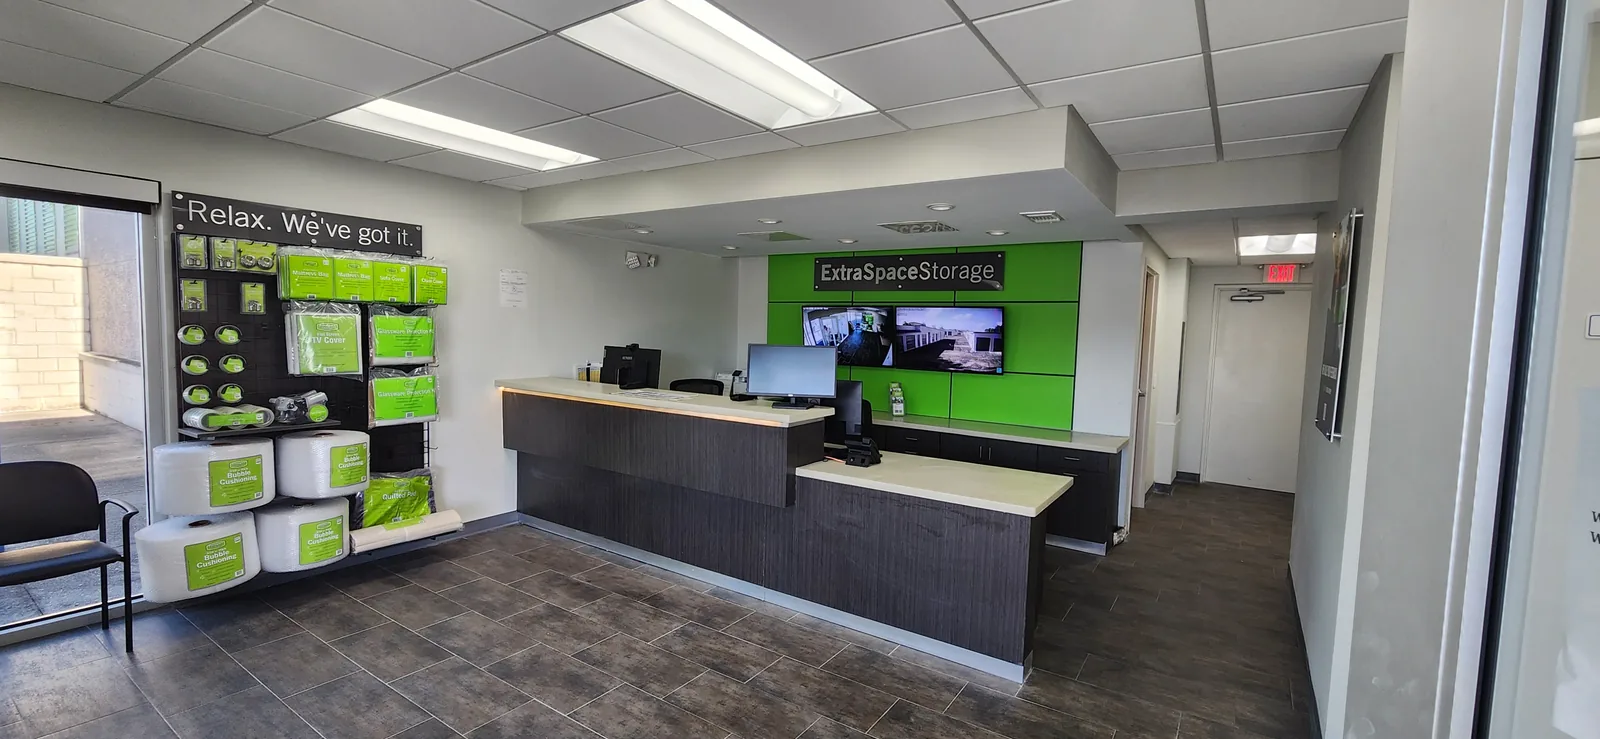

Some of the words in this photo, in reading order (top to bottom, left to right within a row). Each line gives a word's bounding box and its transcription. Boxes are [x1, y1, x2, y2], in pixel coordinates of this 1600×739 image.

[188, 199, 272, 231] Relax.
[281, 211, 351, 239] We've
[358, 226, 391, 246] got
[397, 227, 413, 247] it.
[1267, 264, 1296, 283] EXIT
[324, 336, 346, 344] Cover
[344, 455, 360, 463] Bubble
[227, 469, 251, 479] Bubble
[219, 475, 258, 485] Cushioning
[382, 492, 406, 500] Quilted
[314, 530, 334, 539] Bubble
[196, 553, 238, 568] Cushioning
[204, 550, 230, 561] Bubble
